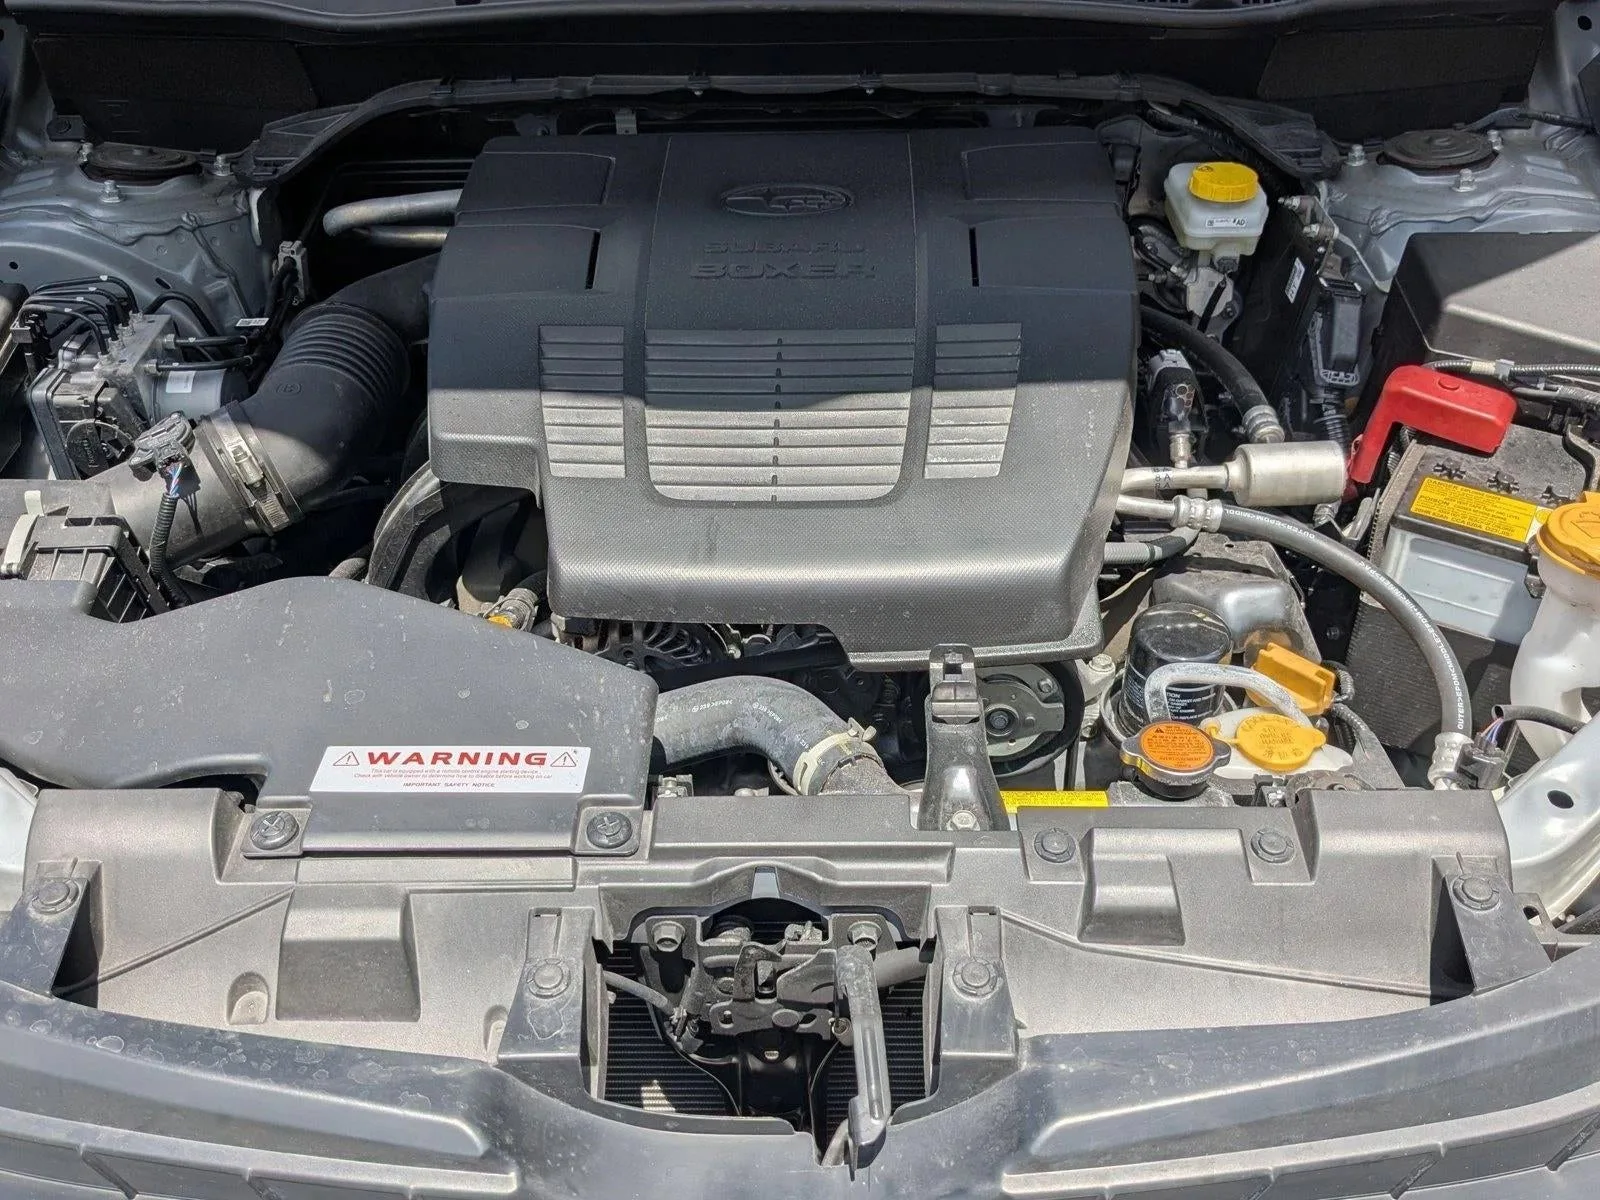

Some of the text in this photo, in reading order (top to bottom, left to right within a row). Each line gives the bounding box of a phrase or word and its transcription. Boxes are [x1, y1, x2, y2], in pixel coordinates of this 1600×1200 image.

[703, 242, 866, 255] SUBARU
[691, 263, 878, 279] BOXER
[1419, 494, 1449, 506] POISON
[368, 752, 548, 766] WARNING
